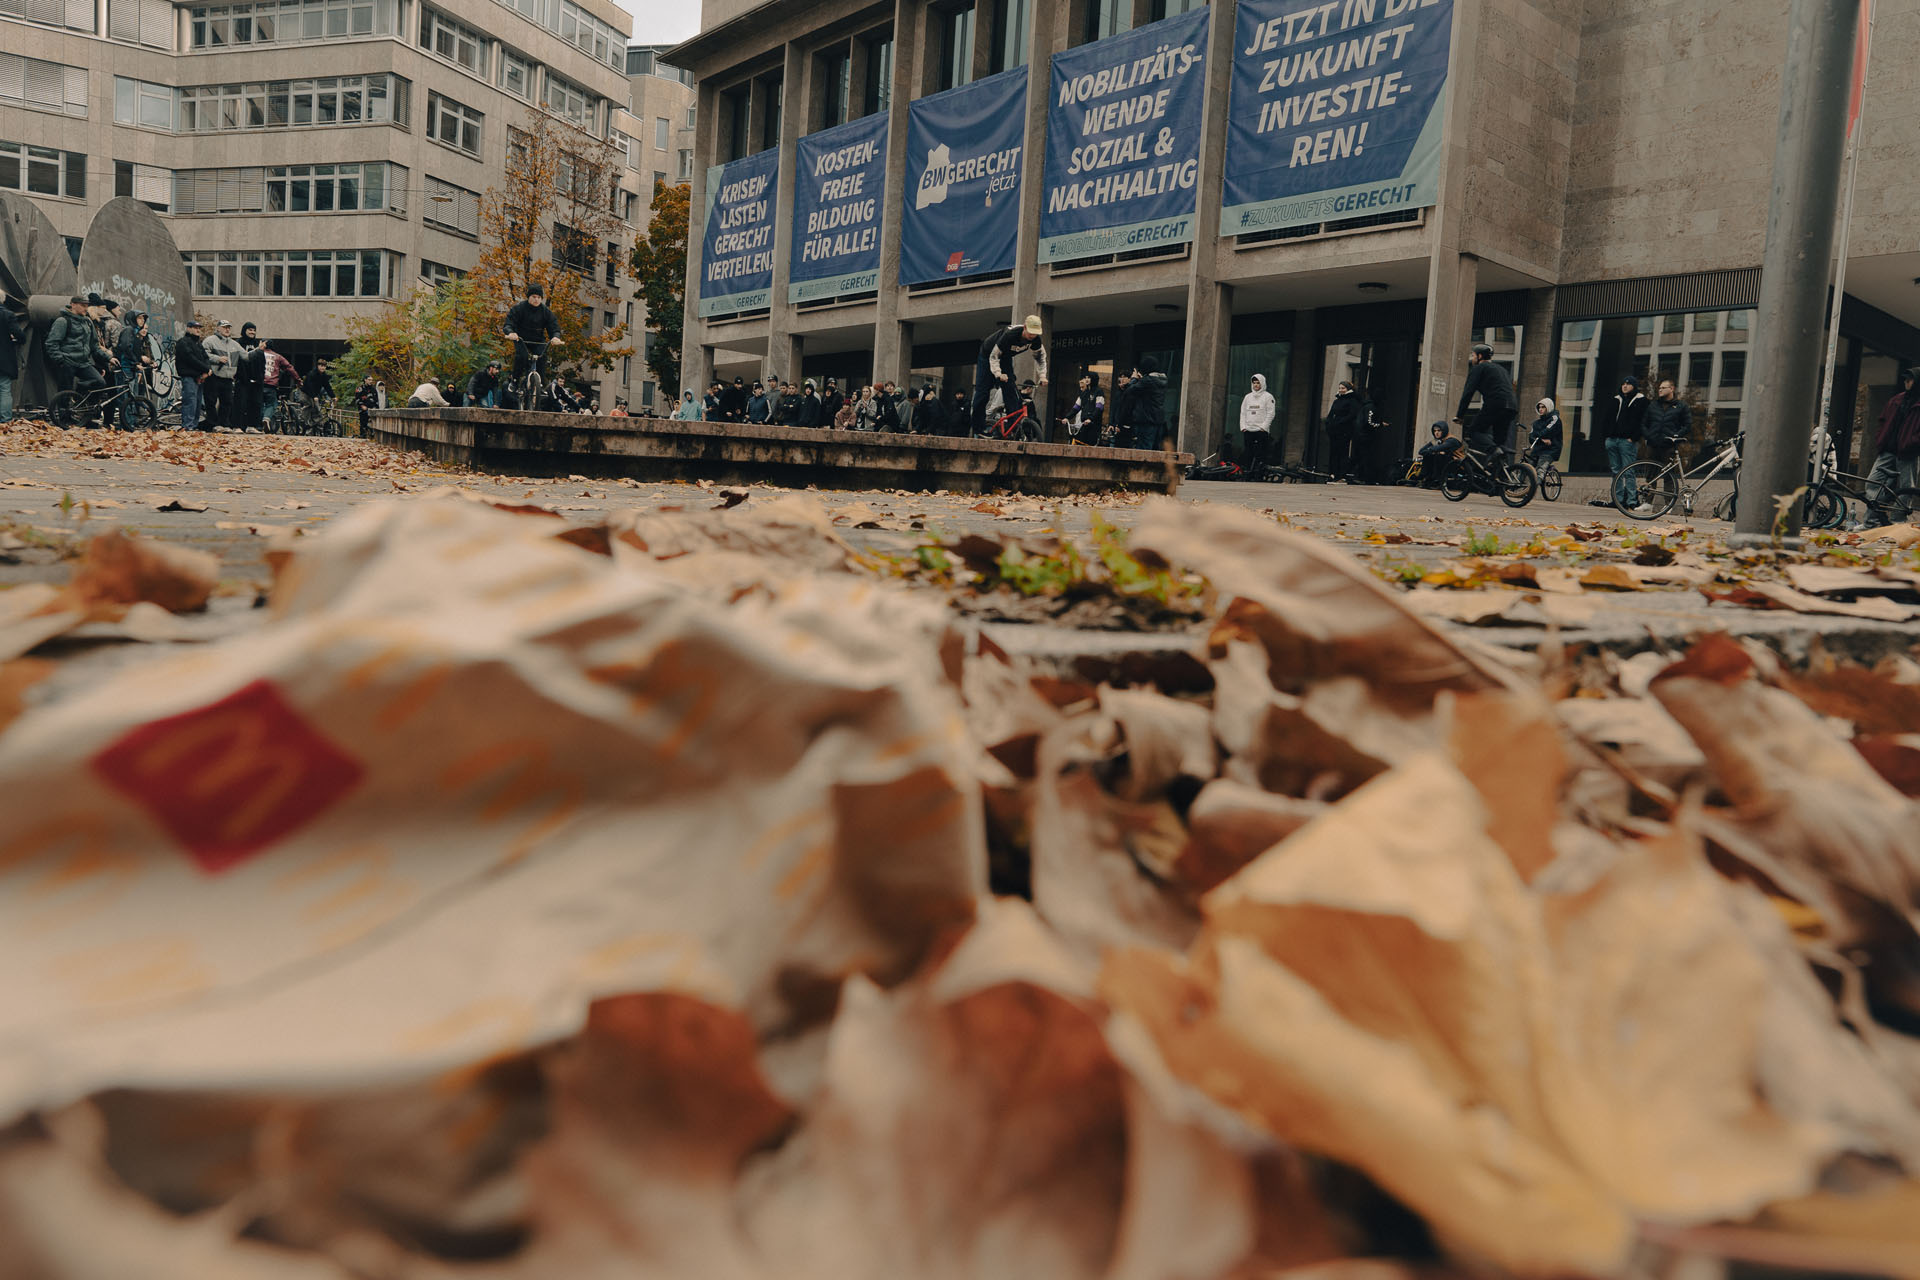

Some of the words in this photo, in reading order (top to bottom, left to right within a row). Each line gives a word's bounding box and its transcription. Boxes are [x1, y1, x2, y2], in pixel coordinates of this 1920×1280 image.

[1244, 1, 1339, 56] JETZT
[1340, 0, 1377, 30] IN
[1058, 44, 1203, 108] MOBILITÄTS-
[1258, 24, 1415, 94] ZUKUNFT
[1082, 88, 1171, 137] WENDE
[1256, 71, 1412, 134] INVESTIE-
[814, 140, 879, 177] KOSTEN-
[1067, 132, 1148, 175] SOZIAL
[1154, 126, 1176, 157] &
[1289, 122, 1369, 169] REN!
[720, 174, 768, 205] KRISEN-
[820, 172, 865, 203] FREIE
[1048, 158, 1198, 214] NACHHALTIG
[1240, 183, 1417, 228] #ZUKUNFTSGERECHT
[720, 200, 767, 229] LASTEN
[807, 199, 875, 234] BILDUNG
[715, 225, 771, 255] GERECHT
[802, 234, 831, 263] FÜR
[832, 226, 877, 257] ALLE!
